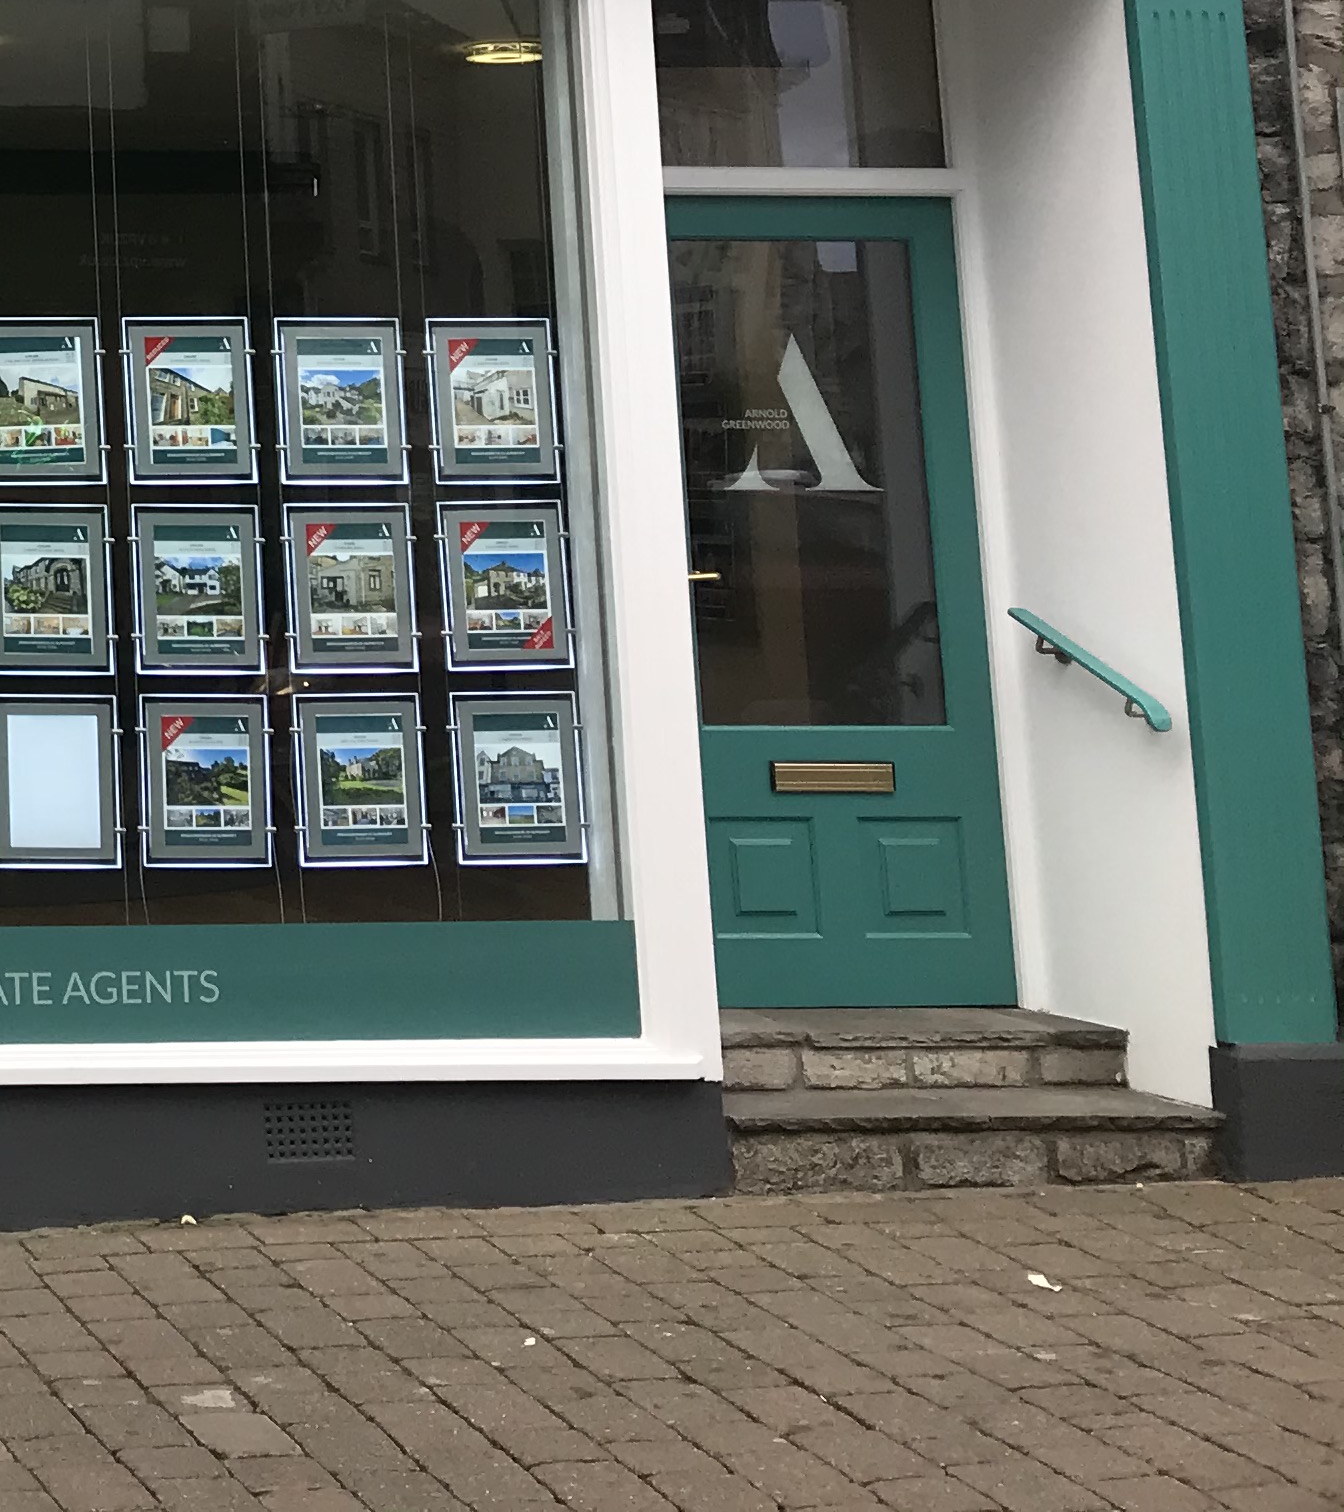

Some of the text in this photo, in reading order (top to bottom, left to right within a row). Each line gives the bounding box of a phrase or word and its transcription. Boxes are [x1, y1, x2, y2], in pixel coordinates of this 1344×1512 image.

[450, 341, 469, 363] NEW
[721, 419, 790, 430] GREENWOOD
[744, 408, 788, 419] ARNOLD
[308, 525, 328, 548] NEW
[461, 523, 481, 545] NEW
[164, 717, 184, 740] NEW
[62, 969, 220, 1005] AGENTS
